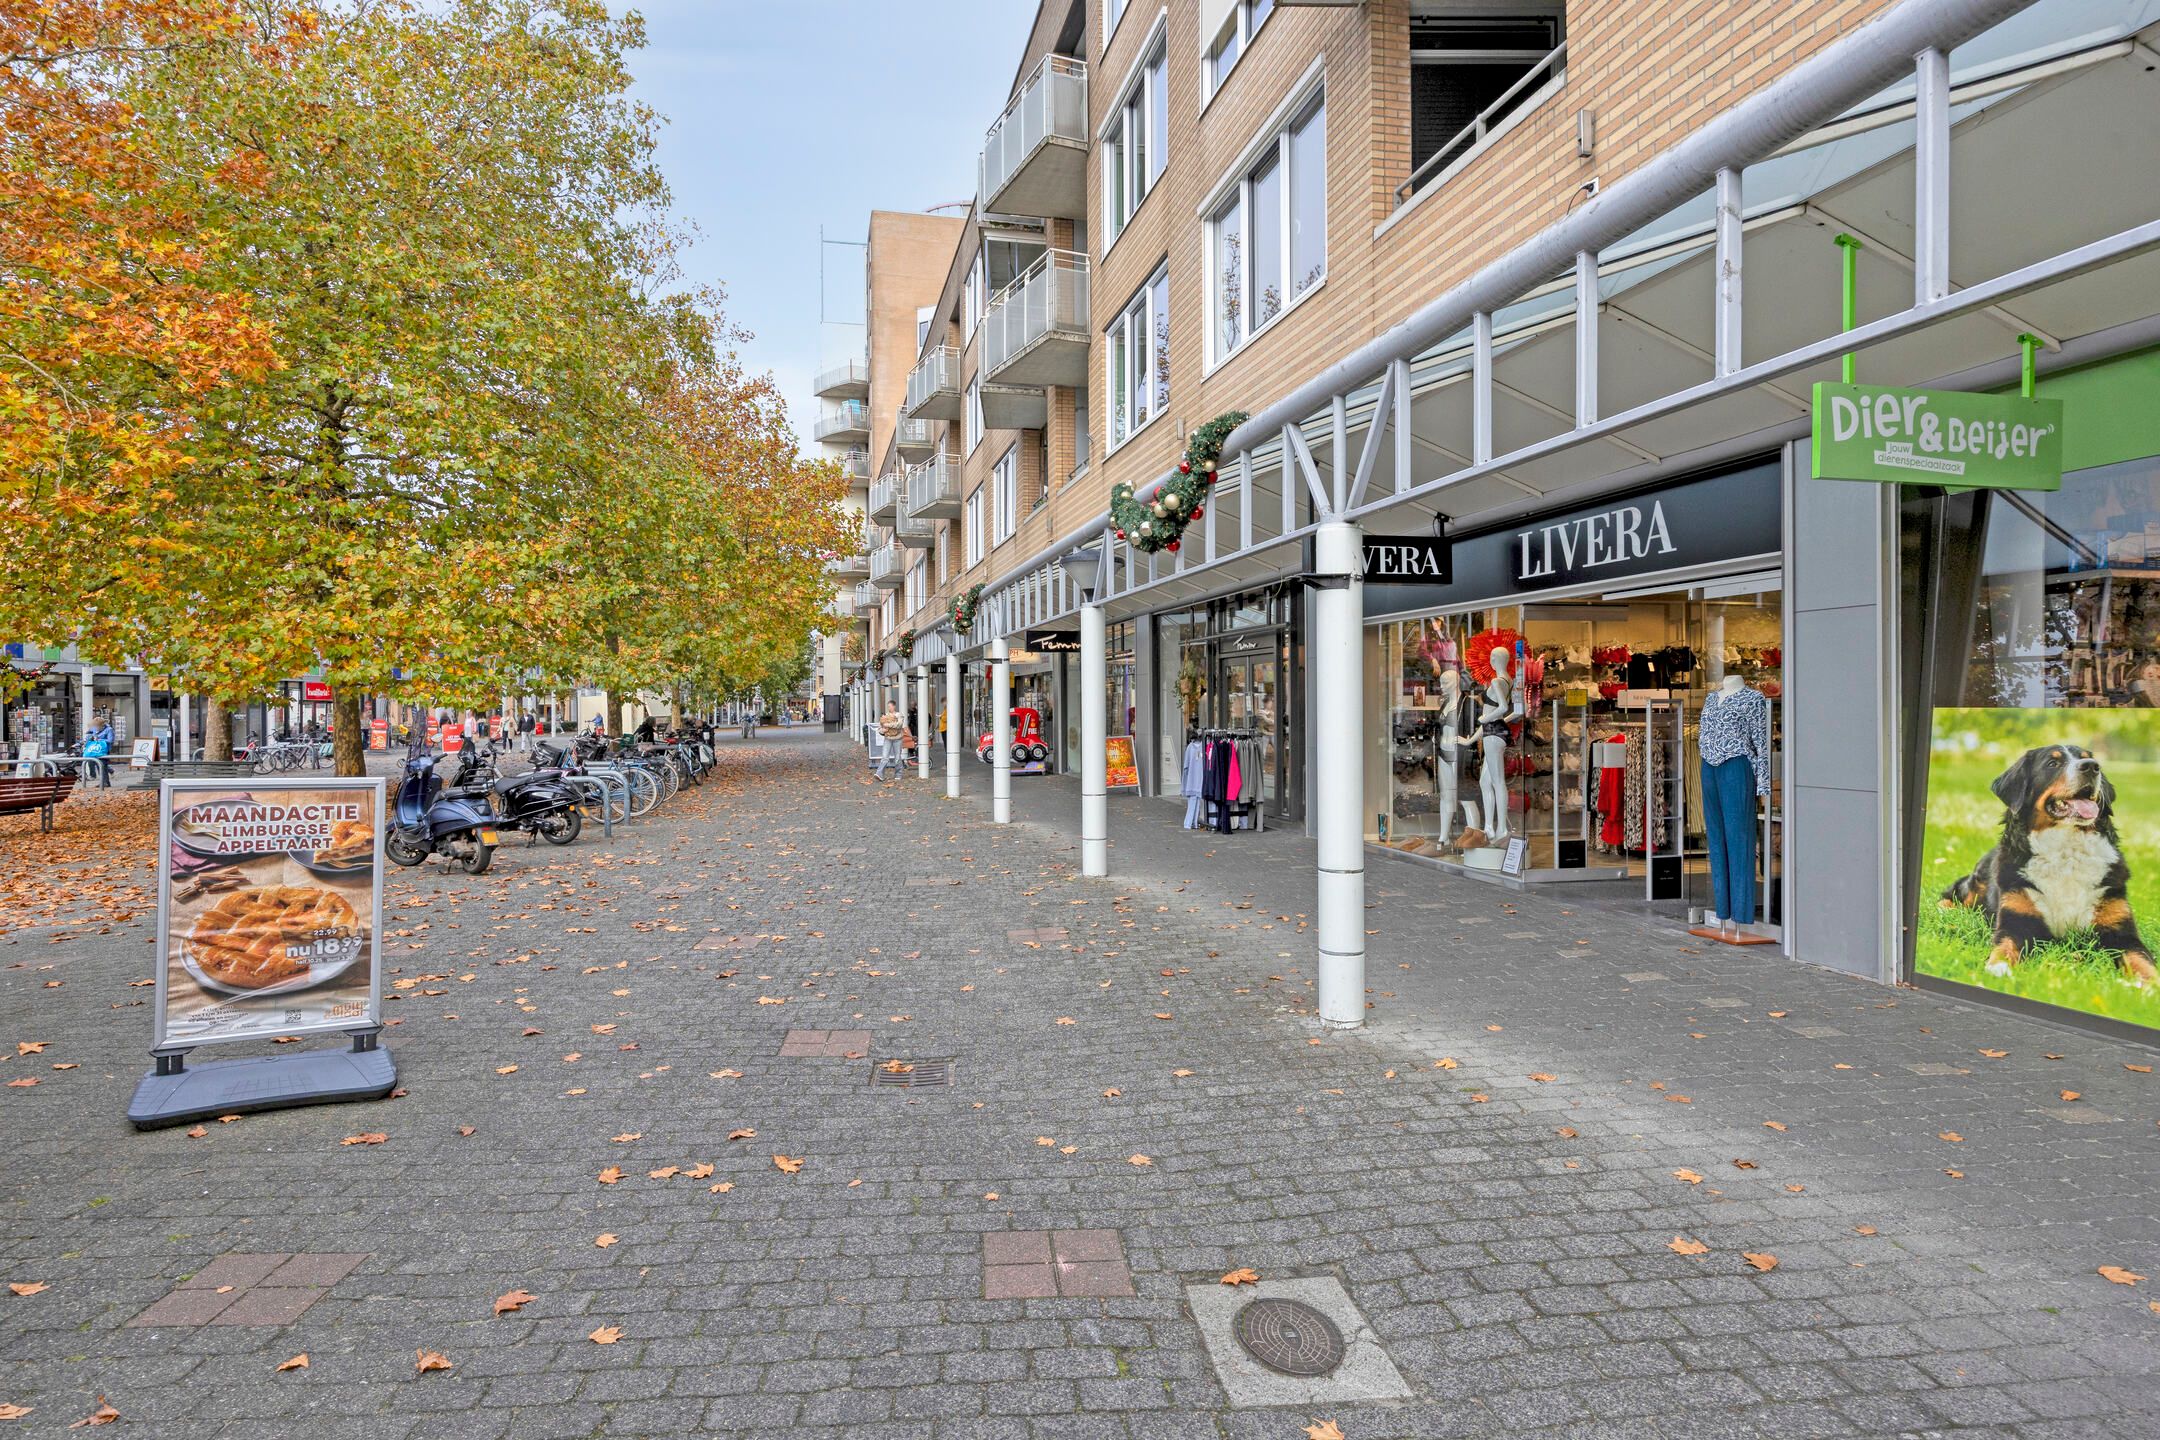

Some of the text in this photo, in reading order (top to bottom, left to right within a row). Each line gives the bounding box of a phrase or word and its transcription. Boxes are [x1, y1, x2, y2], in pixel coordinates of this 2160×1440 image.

[1831, 394, 1928, 441] Dier
[1889, 443, 1911, 455] jouw
[1877, 453, 1962, 473] dierenspeciaalzaak
[1518, 500, 1677, 580] LIVERA
[1361, 545, 1443, 576] VERA
[191, 805, 358, 824] MAANDACTIE
[222, 823, 329, 838] LIMBURGSE
[217, 837, 333, 852] APPELTAART
[286, 945, 311, 958] nu
